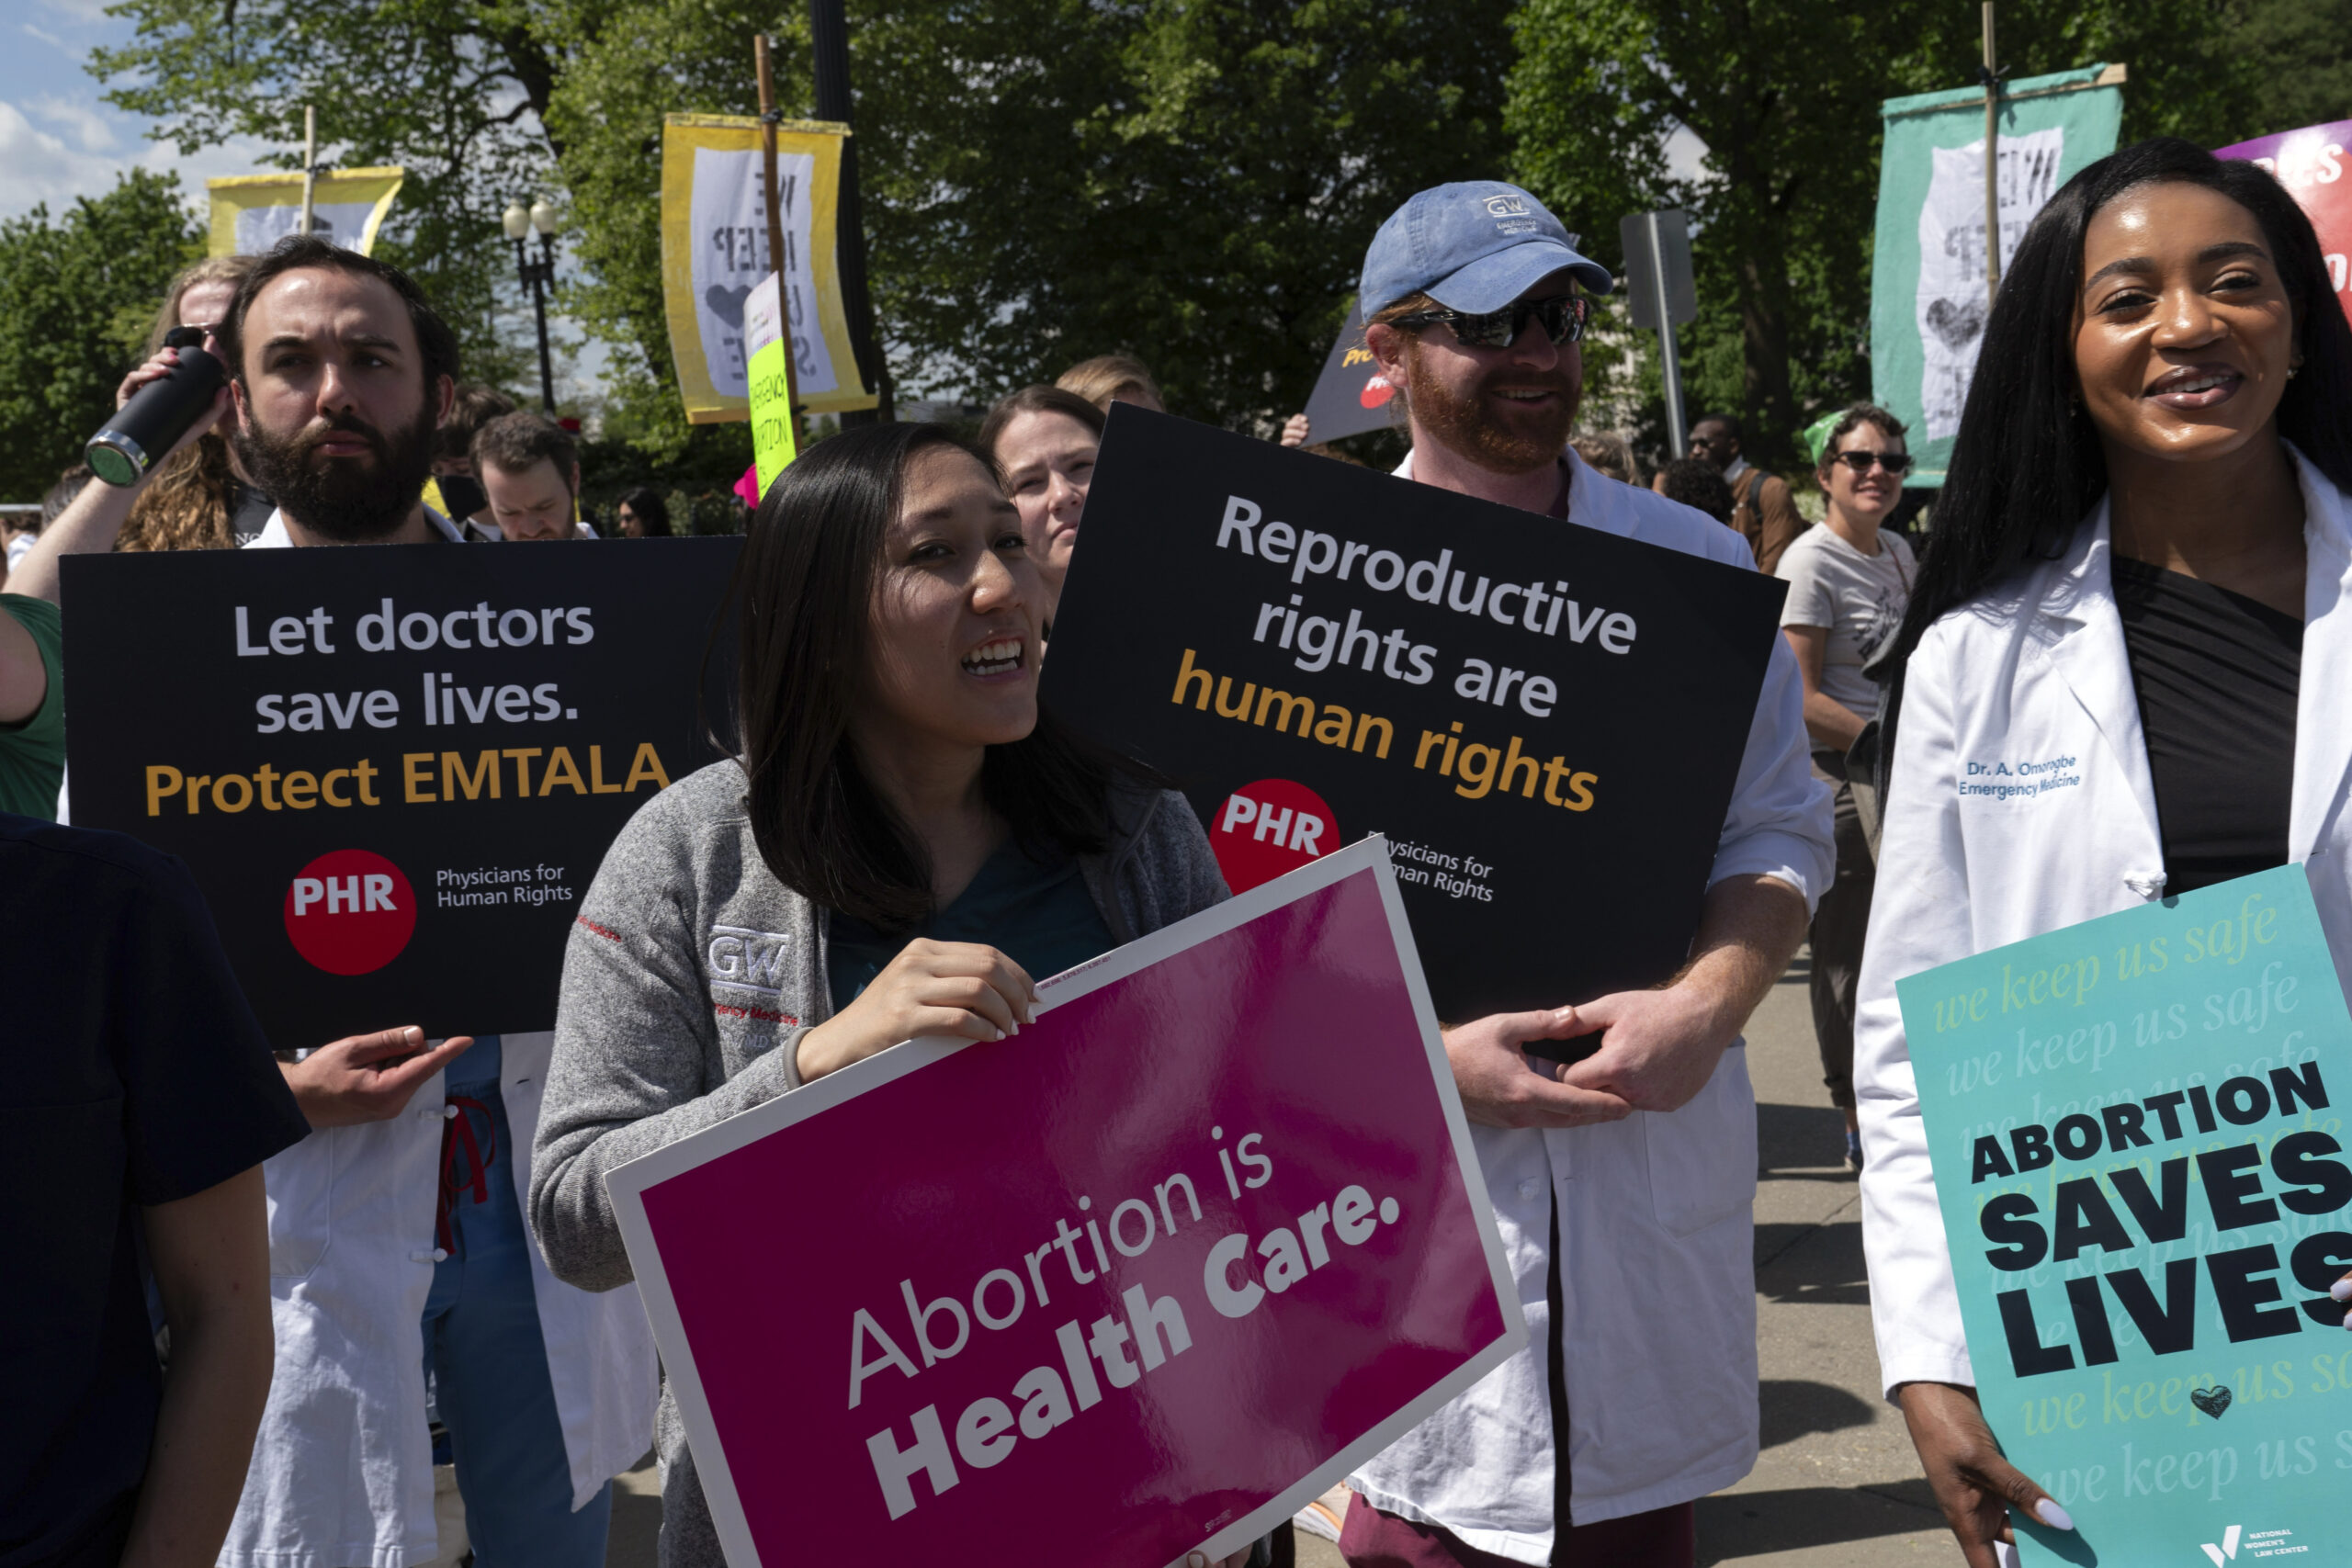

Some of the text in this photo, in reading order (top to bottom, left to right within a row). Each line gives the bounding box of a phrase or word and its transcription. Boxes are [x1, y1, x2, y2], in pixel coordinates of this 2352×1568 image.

[1216, 494, 1637, 655] Reproductive
[234, 597, 595, 657] Let doctors
[1252, 593, 1559, 718] rights are
[254, 671, 579, 734] save lives.
[1170, 648, 1600, 813] human rights
[144, 742, 672, 817] Protect EMTALA
[1959, 772, 2080, 801] Emergency Medicine
[1966, 761, 1992, 776] Dr.
[1995, 761, 2013, 776] A.
[1221, 793, 1325, 857] PHR
[1368, 829, 1494, 878] ysicians for
[292, 874, 398, 917] PHR
[435, 863, 565, 890] Physicians for
[436, 884, 573, 908] Human Rights
[1391, 863, 1495, 902] man Rights
[708, 936, 787, 984] GW
[1932, 893, 2278, 1034] we keep us safe
[714, 1003, 799, 1027] gency Medicine
[1945, 961, 2300, 1097] we keep us safe
[1971, 1060, 2331, 1185] ABORTION
[1980, 1130, 2352, 1272] SAVES
[847, 1125, 1273, 1411] Abortion is
[1996, 1232, 2352, 1379] LIVES
[865, 1183, 1400, 1522] Health Care.
[2020, 1391, 2088, 1437] we
[2101, 1370, 2218, 1428] keep
[2231, 1359, 2295, 1405] us
[2120, 1441, 2239, 1503] keep
[2254, 1435, 2318, 1481] us
[2243, 1539, 2286, 1550] WOMEN'S
[2248, 1529, 2293, 1540] NATIONAL
[2254, 1545, 2310, 1558] LAW CENTER
